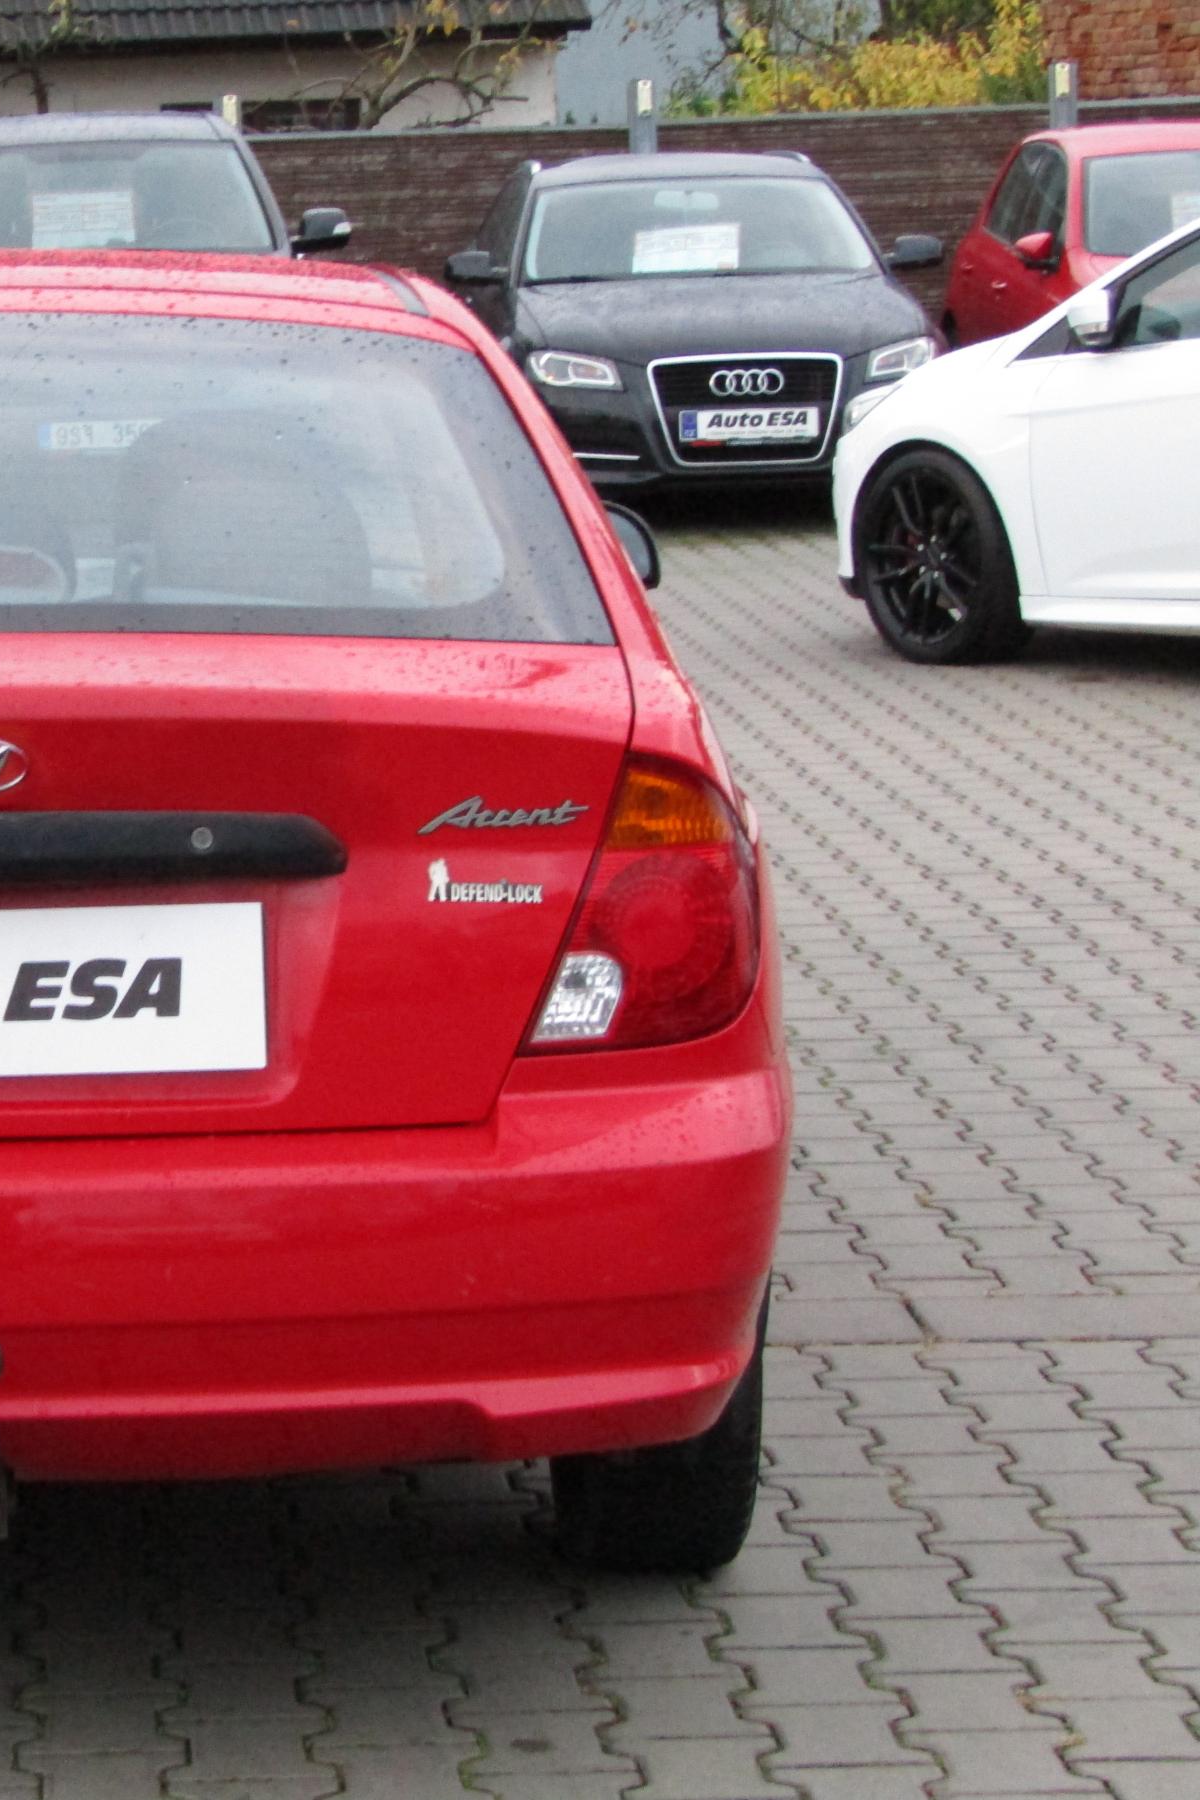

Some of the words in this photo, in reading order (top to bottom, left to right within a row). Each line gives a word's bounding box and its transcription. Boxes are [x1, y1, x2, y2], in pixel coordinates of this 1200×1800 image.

[707, 412, 763, 428] Auto
[766, 410, 809, 426] ESA
[417, 795, 589, 835] Accent
[3, 957, 182, 1022] ESA
